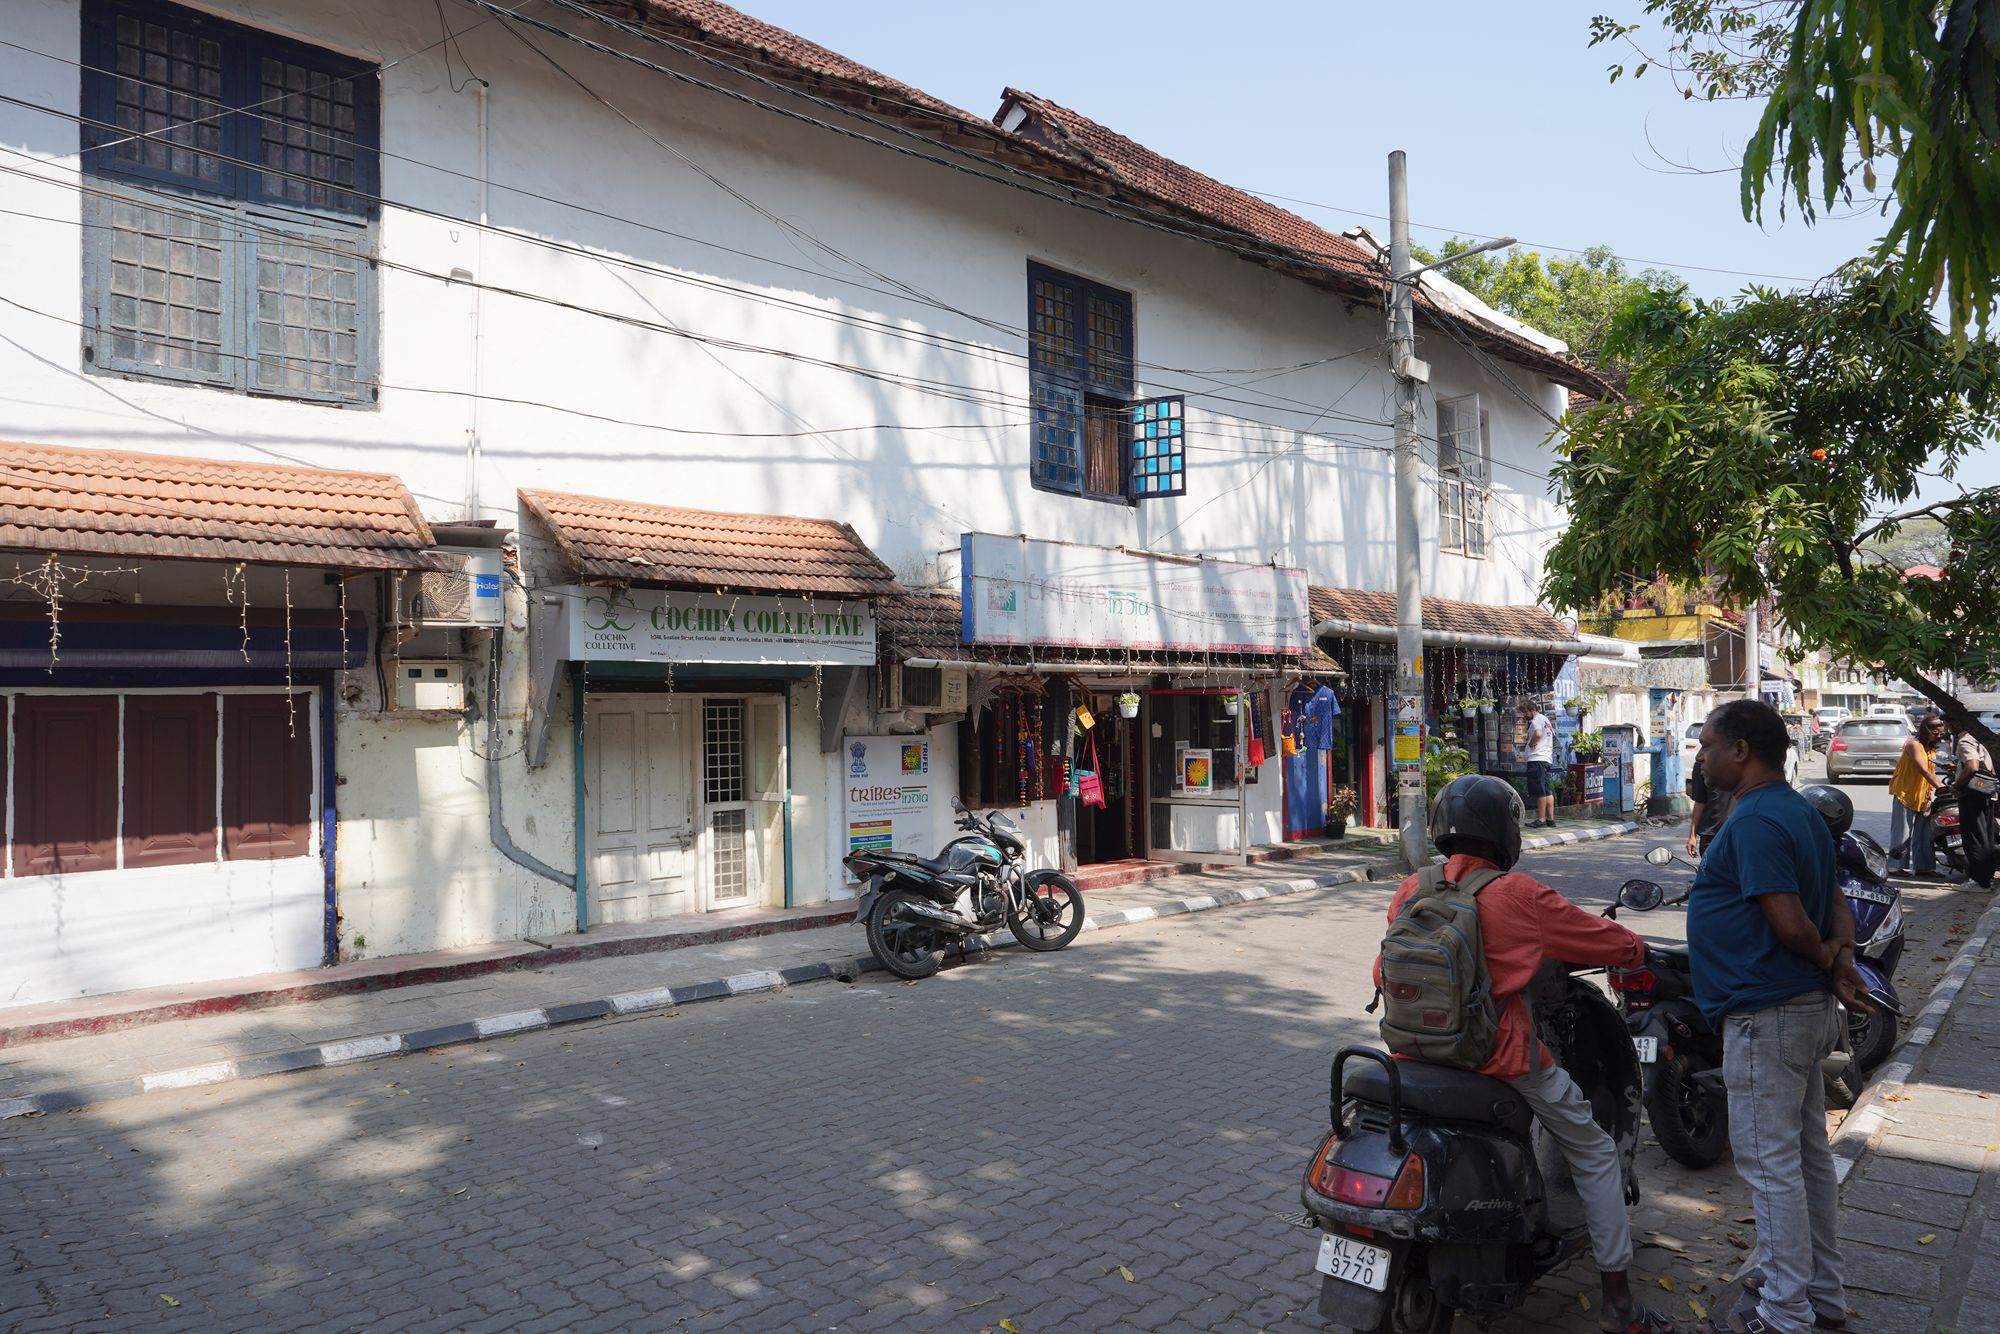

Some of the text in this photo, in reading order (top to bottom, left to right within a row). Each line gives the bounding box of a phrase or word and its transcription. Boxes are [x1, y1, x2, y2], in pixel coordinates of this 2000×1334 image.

[650, 605, 864, 636] COCHIN COLLECTIVE
[594, 633, 627, 641] COCHIN
[585, 641, 636, 650] COLLECTIVE
[1637, 1038, 1649, 1049] 43
[1464, 1199, 1513, 1211] Activa
[1333, 1238, 1376, 1265] KL 43
[1331, 1257, 1374, 1285] 9770
